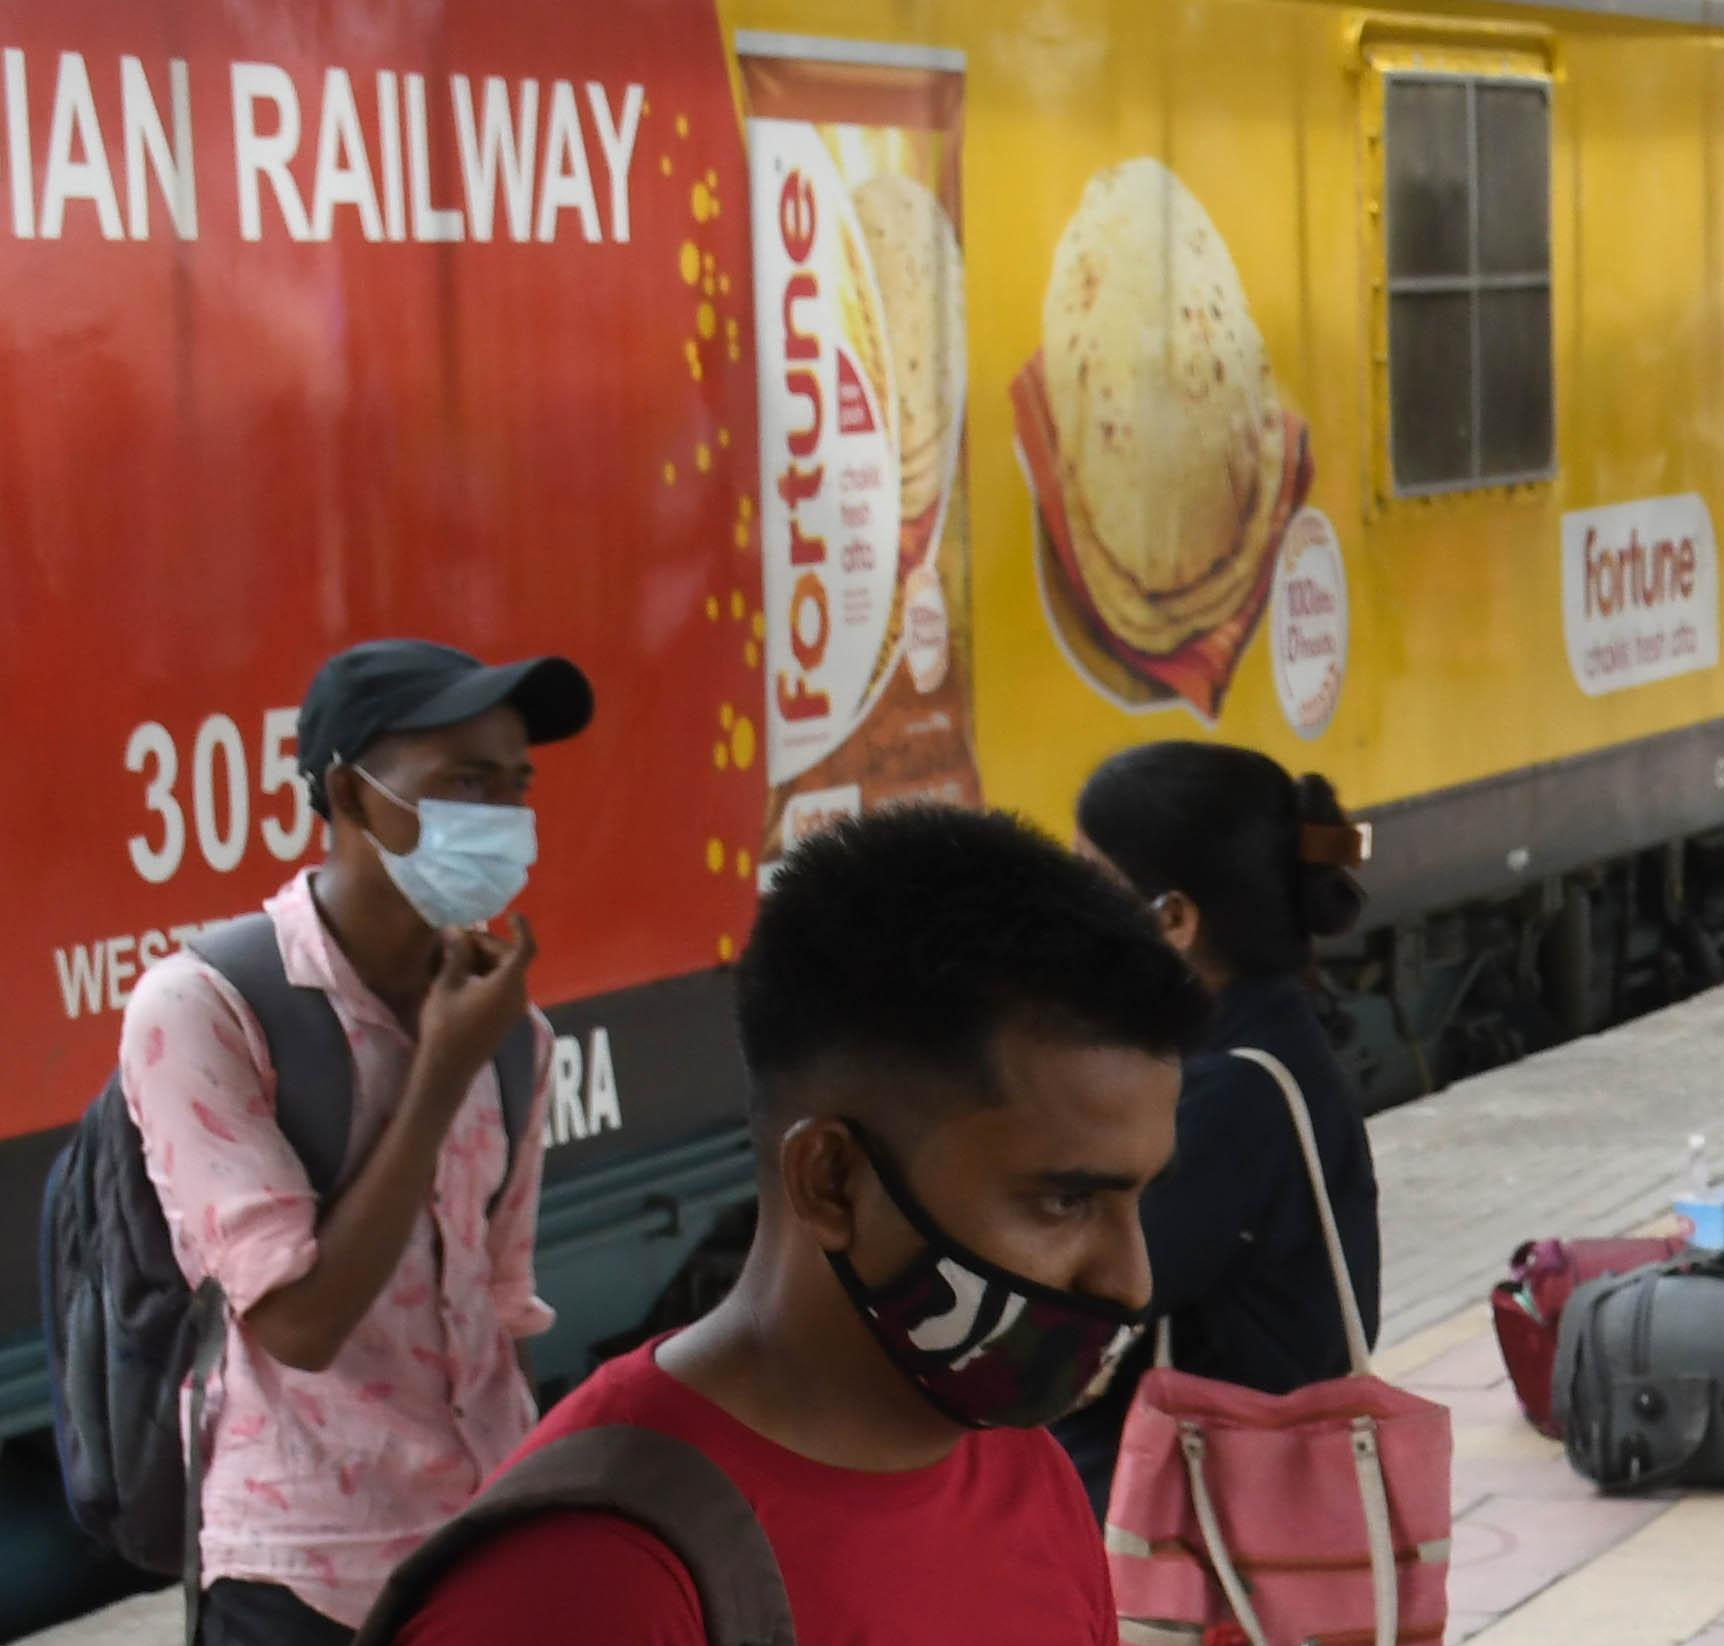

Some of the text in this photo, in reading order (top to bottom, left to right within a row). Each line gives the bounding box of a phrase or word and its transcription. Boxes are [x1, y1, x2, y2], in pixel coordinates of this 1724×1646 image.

[3, 47, 645, 244] IAN RAILWAY
[775, 167, 833, 725] fortune
[1583, 526, 1697, 620] fortune
[125, 705, 332, 885] 305
[541, 1025, 622, 1149] RA
